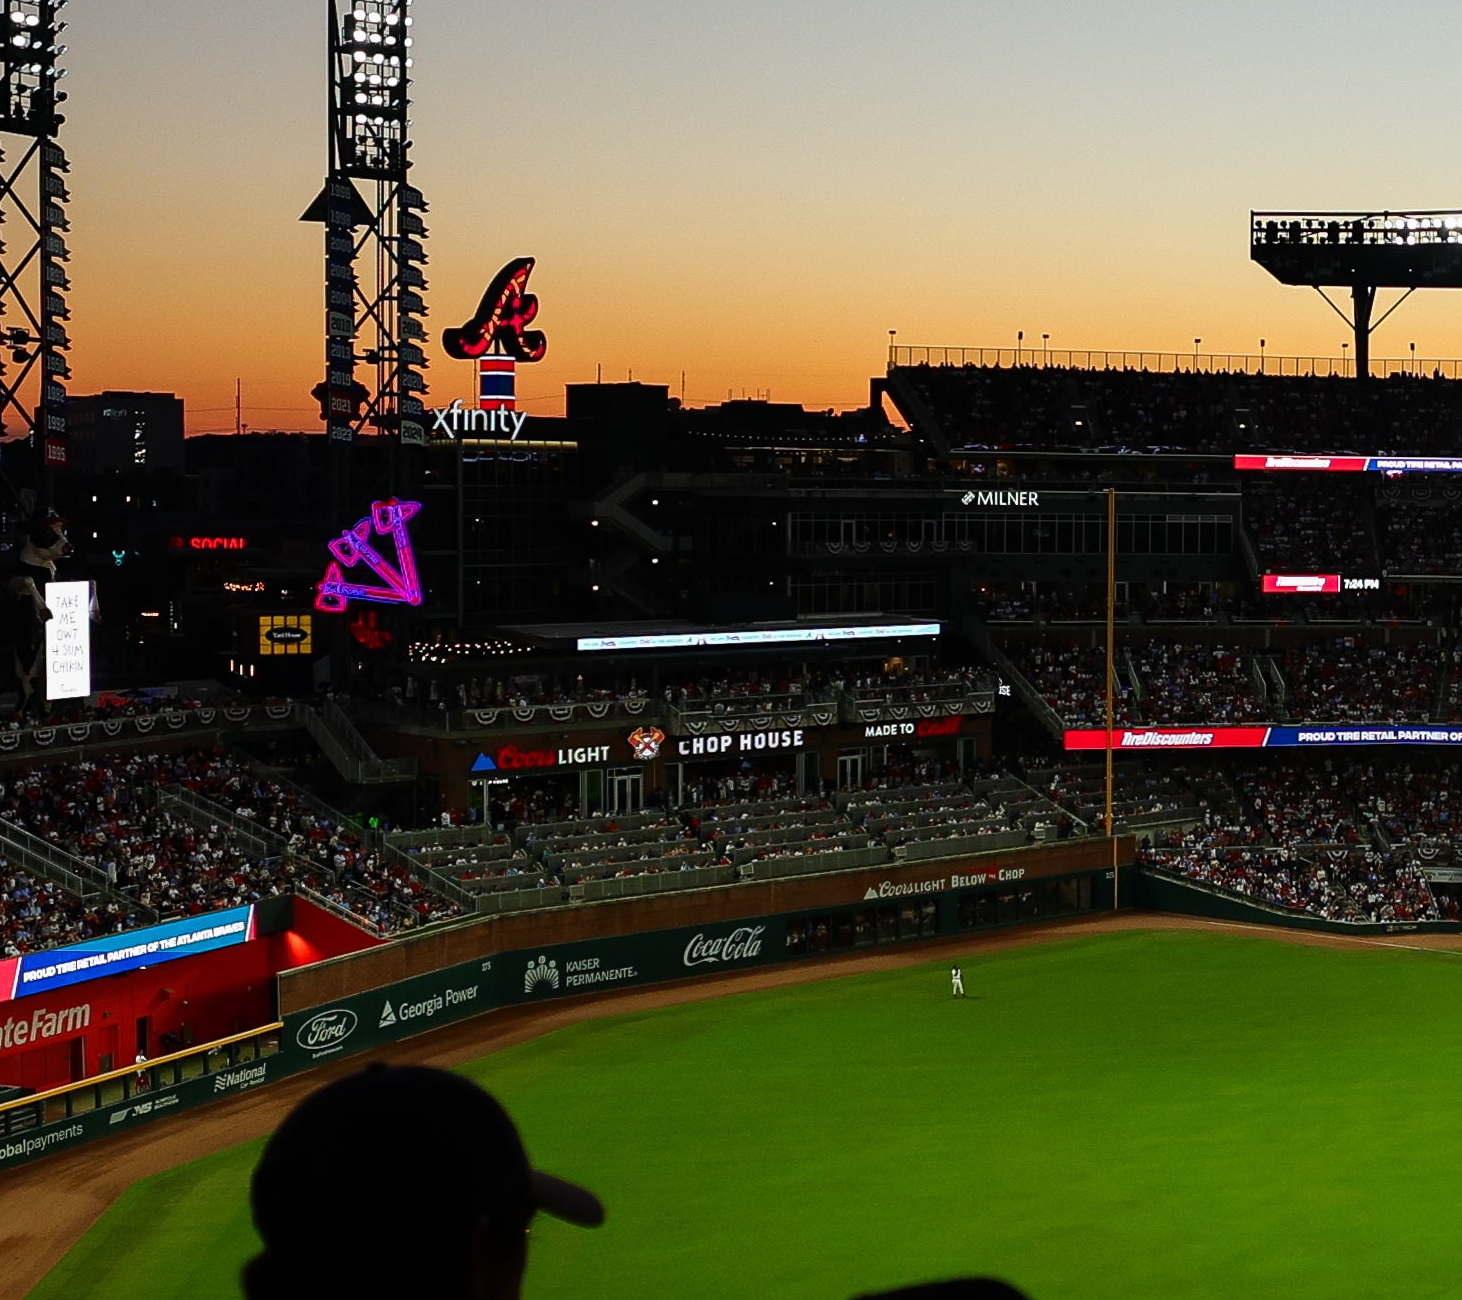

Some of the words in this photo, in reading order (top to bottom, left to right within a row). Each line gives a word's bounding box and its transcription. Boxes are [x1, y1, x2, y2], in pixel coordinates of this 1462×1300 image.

[432, 400, 528, 440] xfinity
[978, 491, 1039, 506] MILNER
[1364, 579, 1379, 590] PM
[56, 595, 79, 608] TAKE
[59, 611, 76, 625] ME
[57, 628, 78, 641] OWT
[63, 645, 84, 656] SUM
[52, 661, 83, 674] CHIKIN
[865, 726, 896, 738] MADE
[900, 723, 914, 735] TO
[1121, 731, 1213, 746] TireDiscounters
[1298, 731, 1335, 742] PROUD
[1337, 731, 1360, 742] TIRE
[1361, 731, 1397, 742] RETAIL
[1398, 731, 1448, 742] PARTNER
[678, 736, 733, 756] CHOP
[740, 731, 804, 751] HOUSE
[496, 745, 555, 770] Coors
[558, 745, 610, 765] LIGHT
[879, 880, 914, 898] Coors
[915, 879, 945, 893] LIGHT
[999, 868, 1025, 881] CHOP
[23, 969, 56, 983] PROUD
[76, 957, 107, 973] RETAIL
[108, 945, 147, 964] PARTNER
[177, 928, 213, 947] ATLANTA
[213, 921, 245, 938] BRAVES
[683, 924, 766, 967] Coca-Cola
[566, 957, 600, 973] KAISER
[566, 967, 634, 987] PERMANENTE
[399, 994, 443, 1022] Georgia
[445, 984, 478, 1004] Power
[307, 1010, 346, 1046] Ford
[225, 1063, 267, 1089] National
